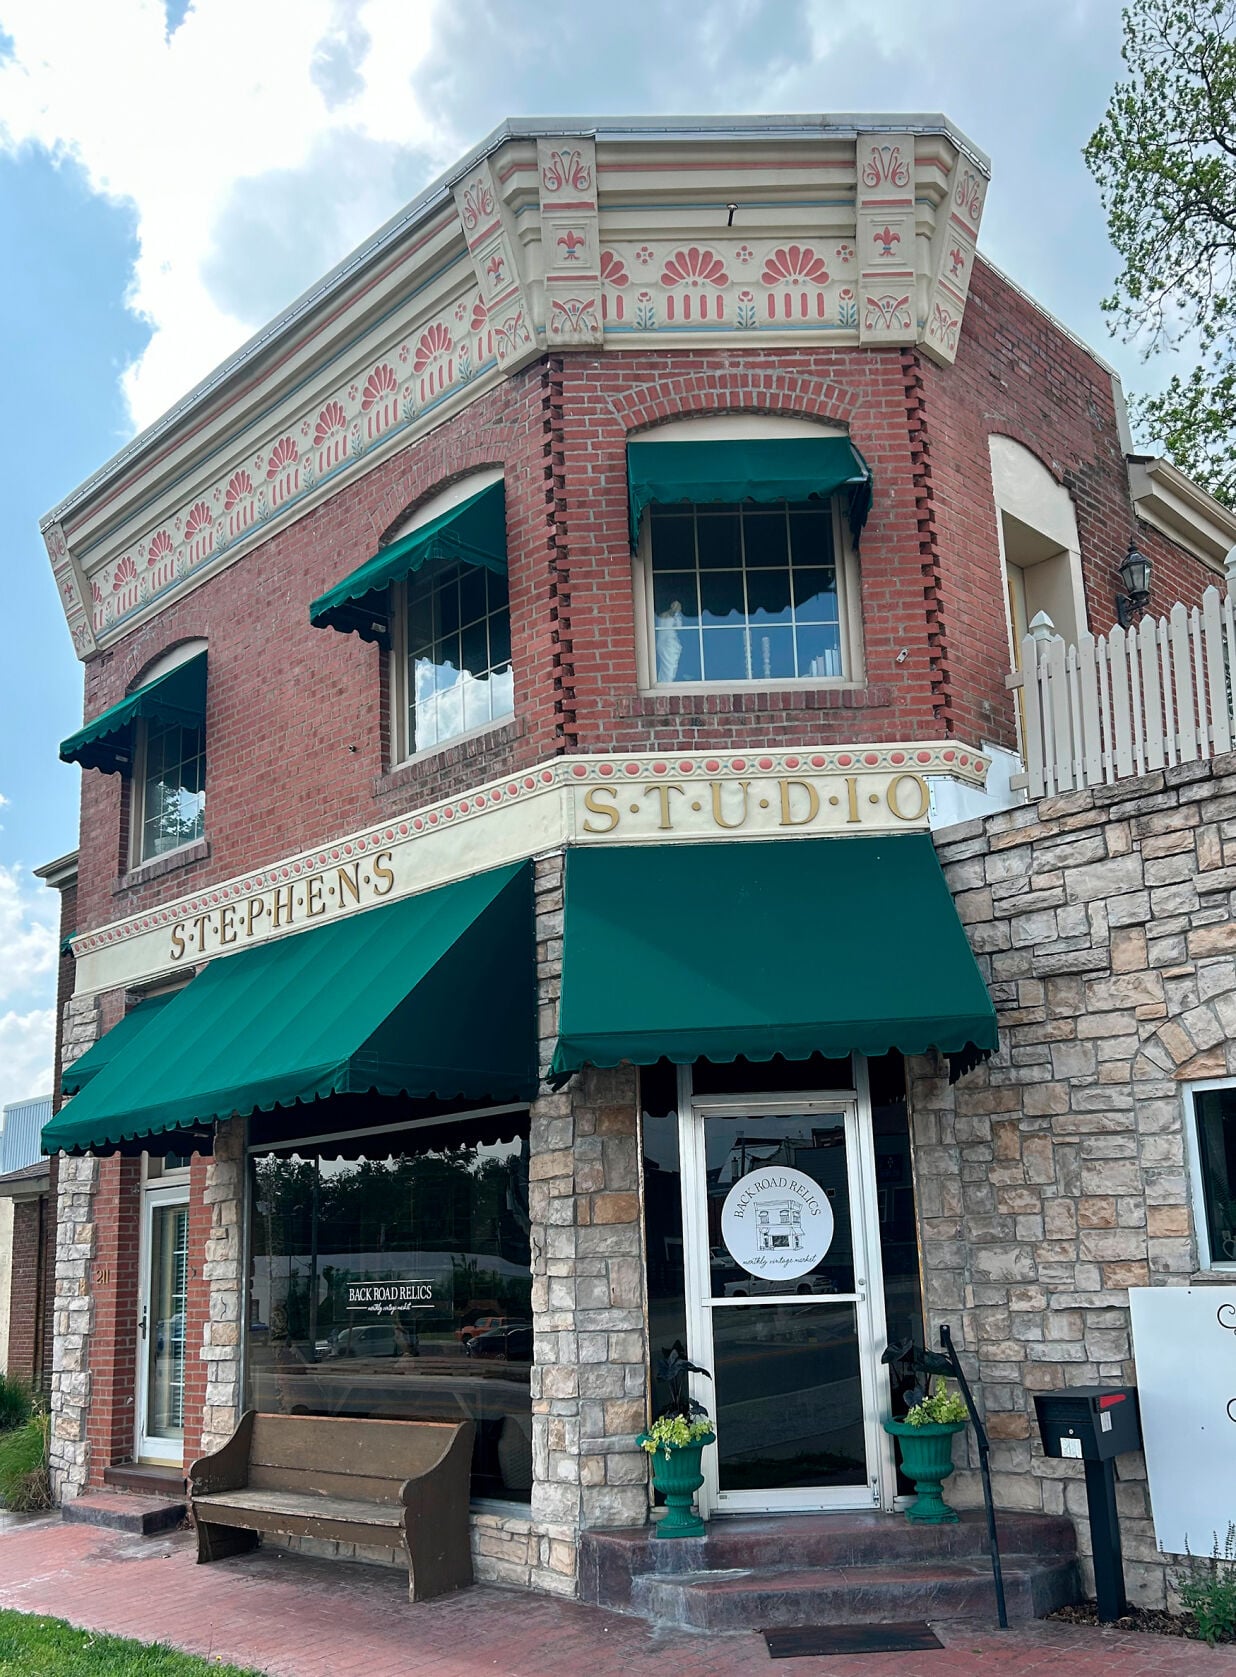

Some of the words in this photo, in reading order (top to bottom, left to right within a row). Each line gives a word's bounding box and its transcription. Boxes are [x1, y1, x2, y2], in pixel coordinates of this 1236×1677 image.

[734, 1187, 757, 1219] BACK
[754, 1177, 787, 1192] ROAD
[789, 1180, 821, 1217] RELICS
[96, 1269, 110, 1285] 211
[349, 1287, 373, 1301] BACK
[373, 1286, 399, 1301] ROAD
[399, 1285, 432, 1300] RELICS
